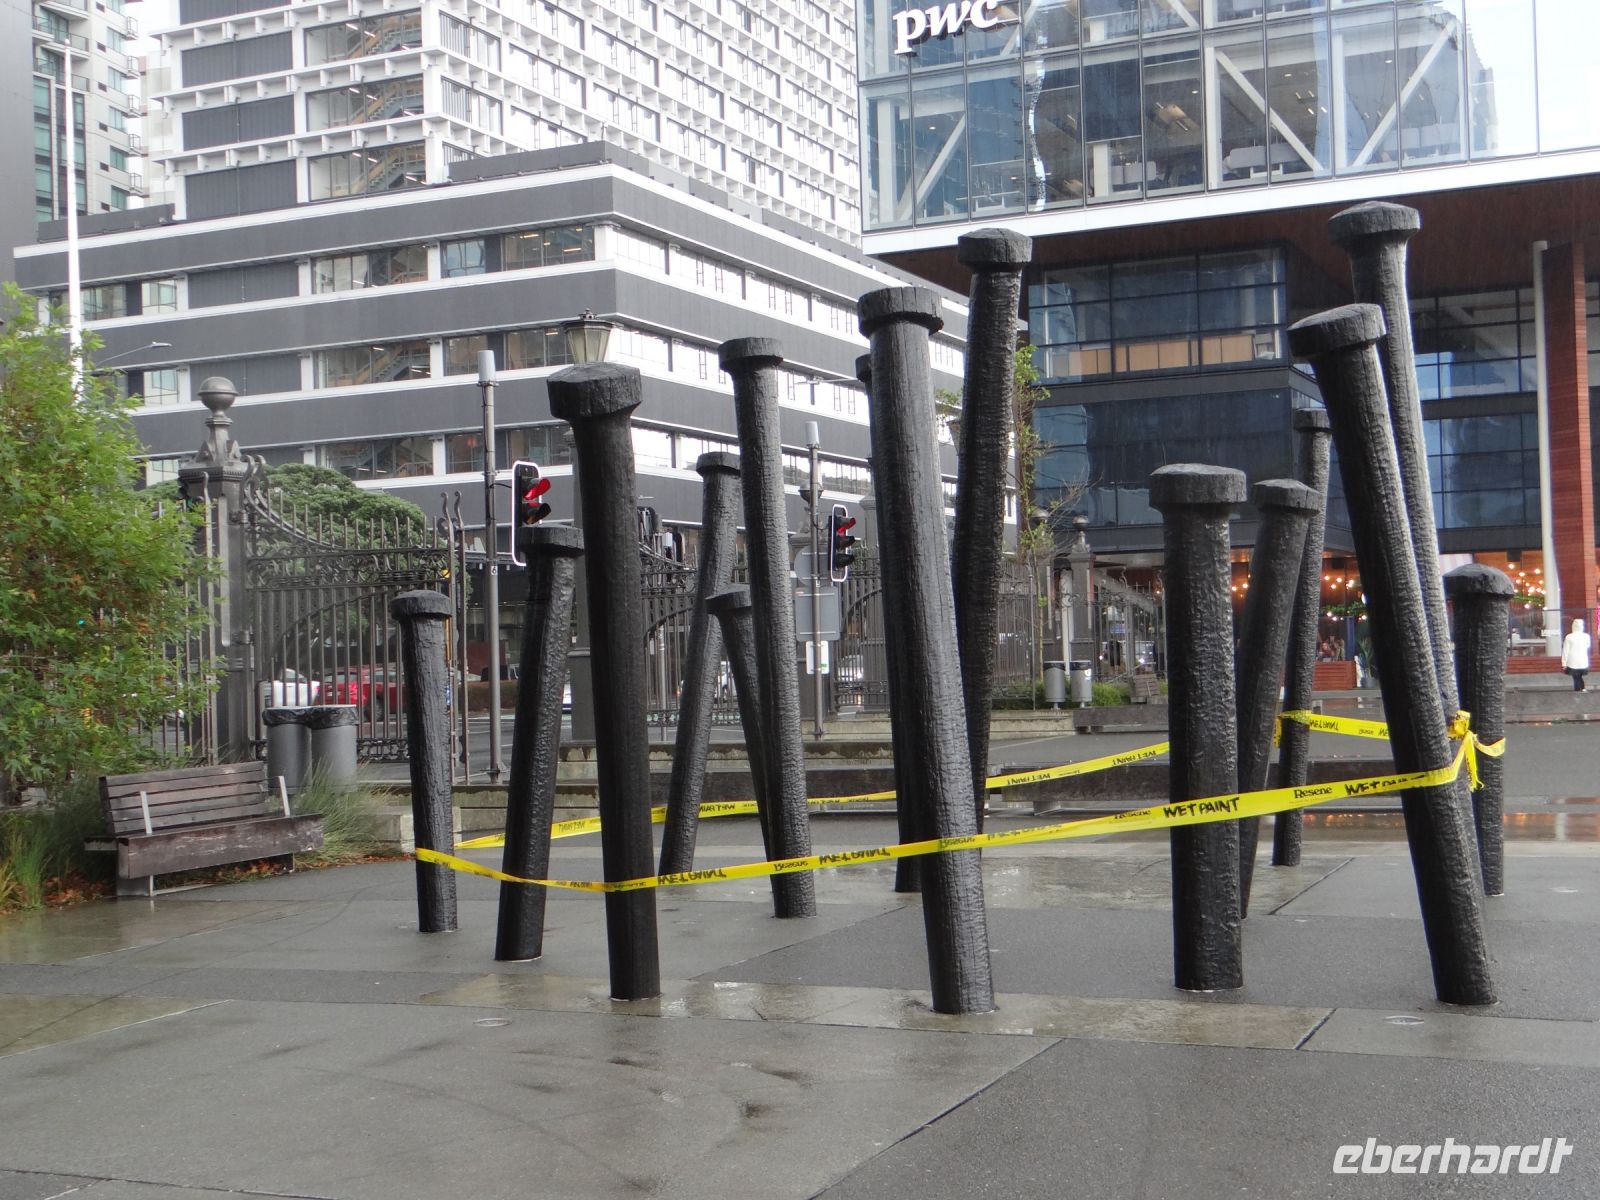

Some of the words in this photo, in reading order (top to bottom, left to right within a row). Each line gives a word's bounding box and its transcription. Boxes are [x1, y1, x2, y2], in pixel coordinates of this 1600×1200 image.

[893, 0, 998, 54] pwc
[1293, 786, 1333, 799] Resene
[1162, 802, 1198, 818] WET
[1199, 796, 1240, 814] PAINT
